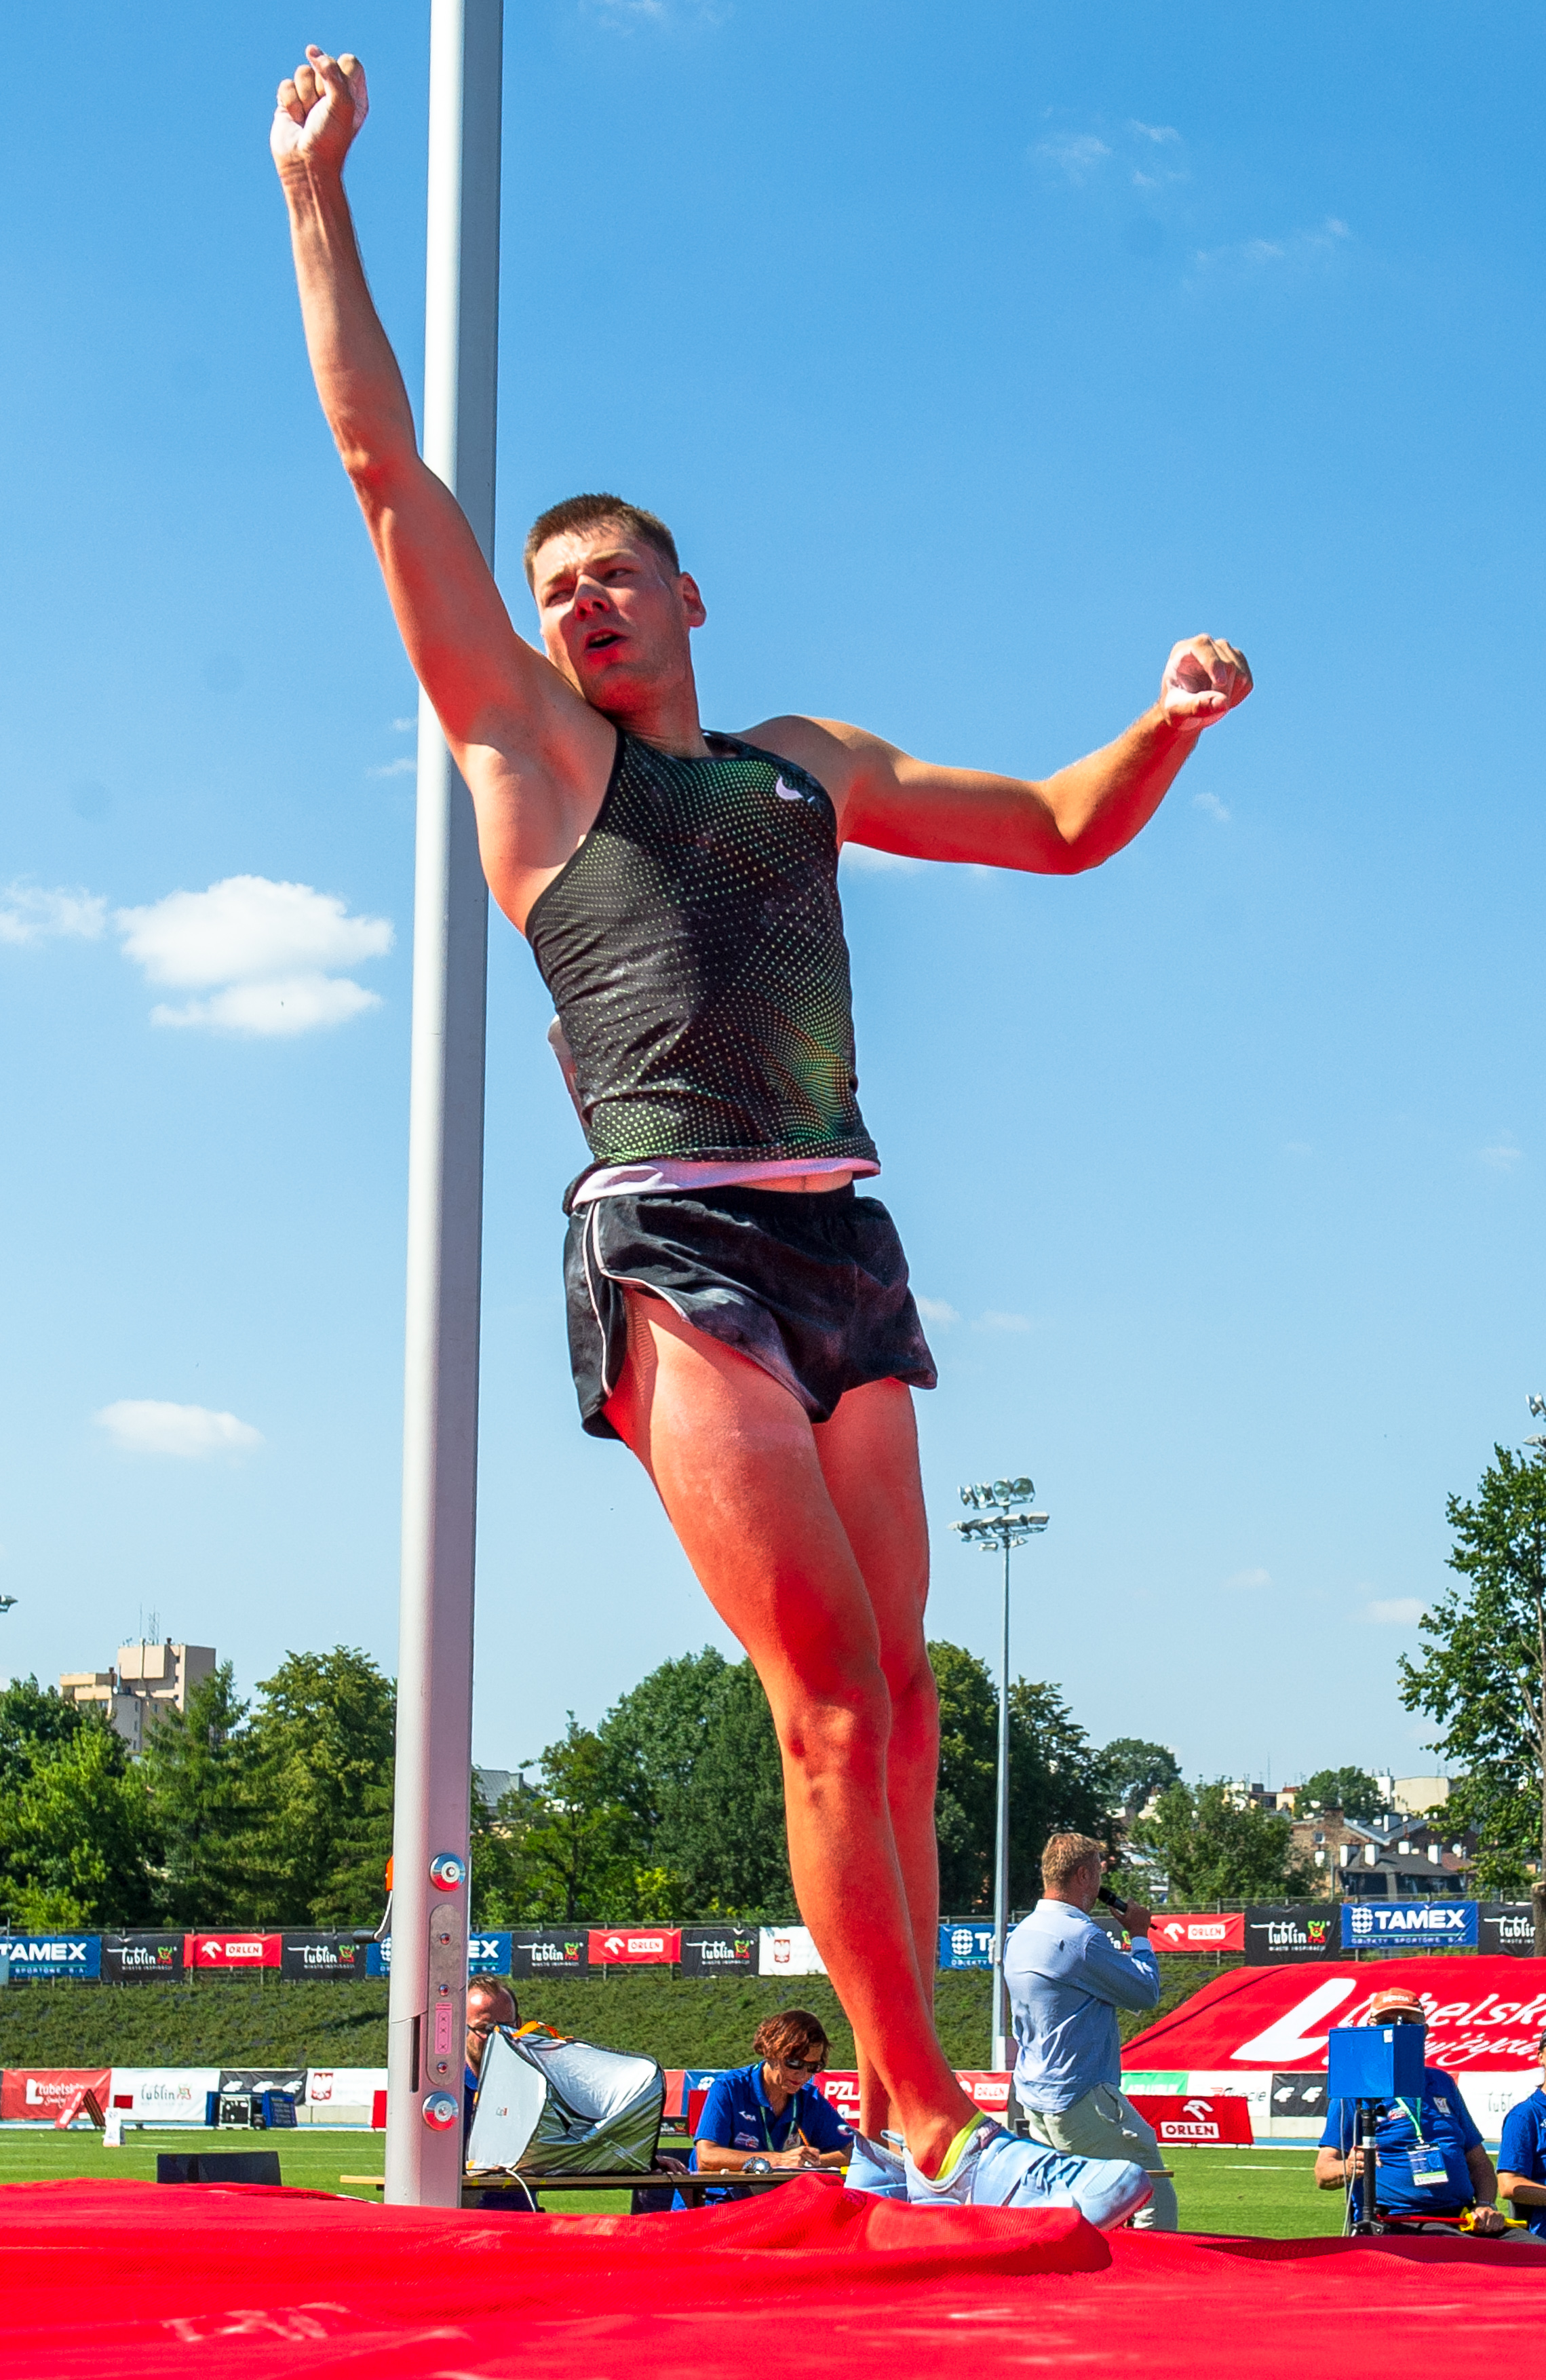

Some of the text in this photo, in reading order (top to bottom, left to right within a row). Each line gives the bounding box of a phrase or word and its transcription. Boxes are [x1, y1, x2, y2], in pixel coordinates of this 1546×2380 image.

[1374, 1909, 1465, 1930] TAMEX
[1191, 1925, 1222, 1937] ORLEN
[229, 1944, 259, 1954] ORLEN
[632, 1939, 660, 1949] ORLEN
[824, 2081, 861, 2100] PZL
[977, 2088, 1005, 2097] ORLEN
[1165, 2124, 1214, 2136] ORLEN
